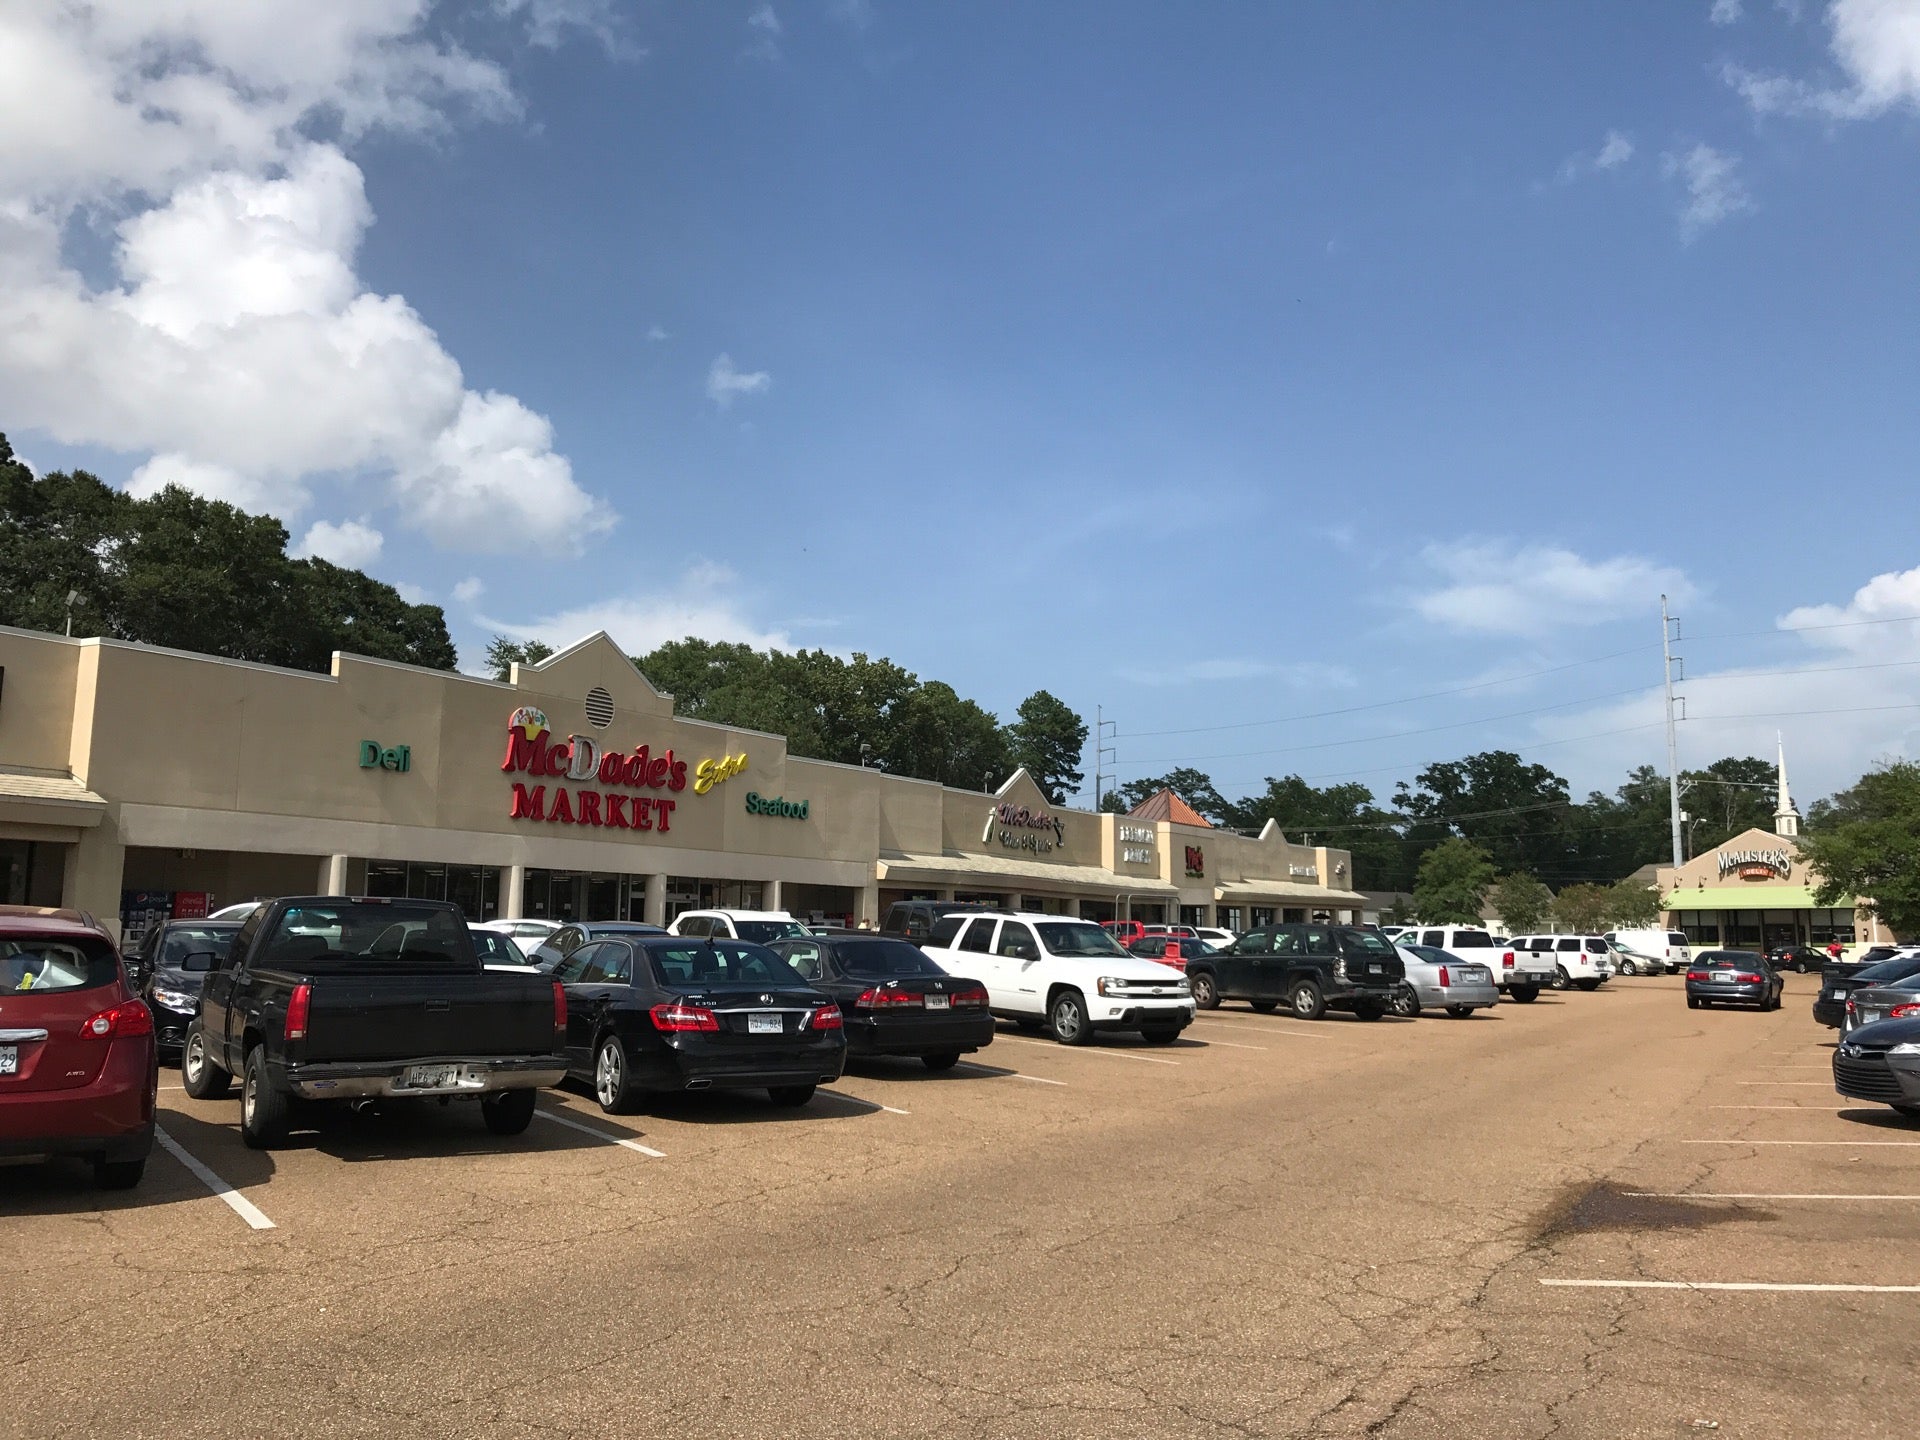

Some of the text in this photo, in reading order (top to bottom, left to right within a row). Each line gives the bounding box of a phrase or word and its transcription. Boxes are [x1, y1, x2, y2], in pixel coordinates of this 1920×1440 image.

[359, 739, 411, 773] Deli
[501, 723, 750, 795] McDade's Extra
[509, 782, 676, 832] MARKET
[745, 791, 809, 820] Seafood
[0, 1053, 16, 1067] 29
